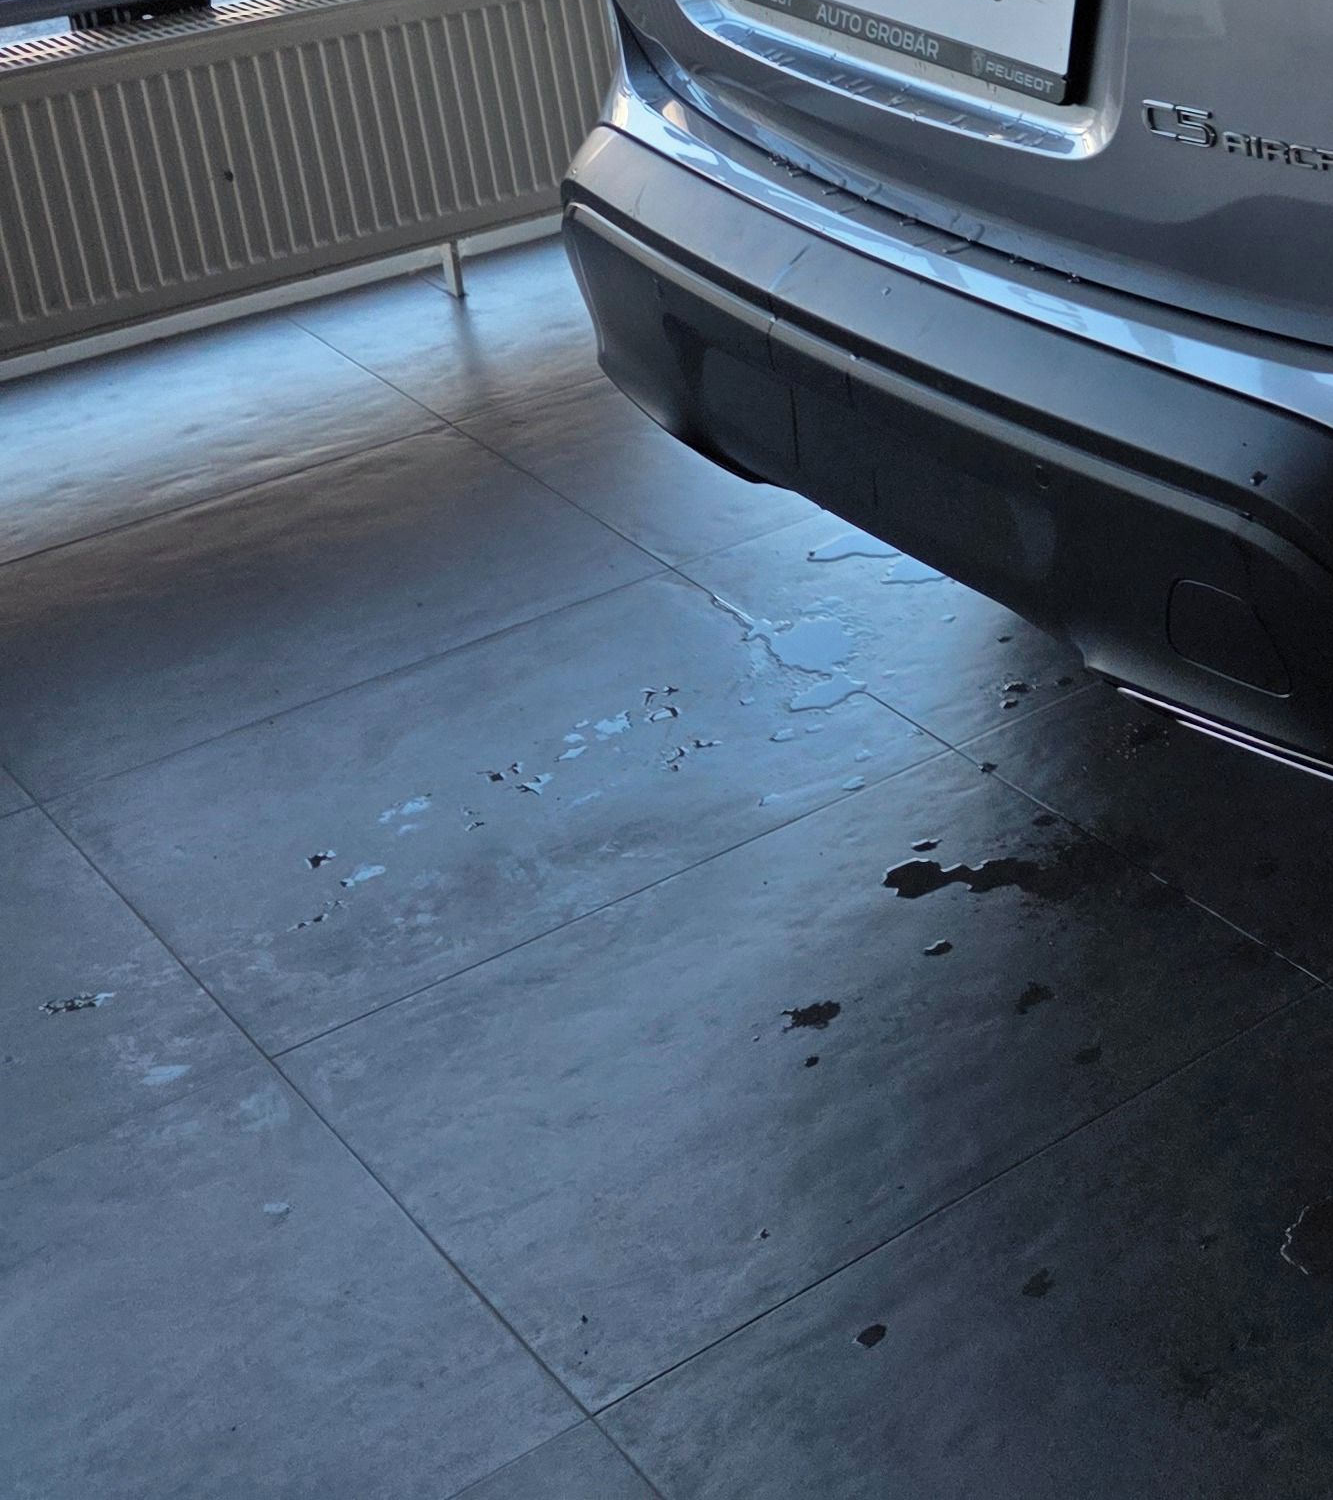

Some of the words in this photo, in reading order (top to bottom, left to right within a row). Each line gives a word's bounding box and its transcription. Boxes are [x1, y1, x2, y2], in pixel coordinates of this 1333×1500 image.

[815, 3, 863, 34] AUTO
[865, 17, 940, 61] GROBÁR
[985, 62, 1054, 93] PEUGEOT
[1142, 98, 1218, 149] C5
